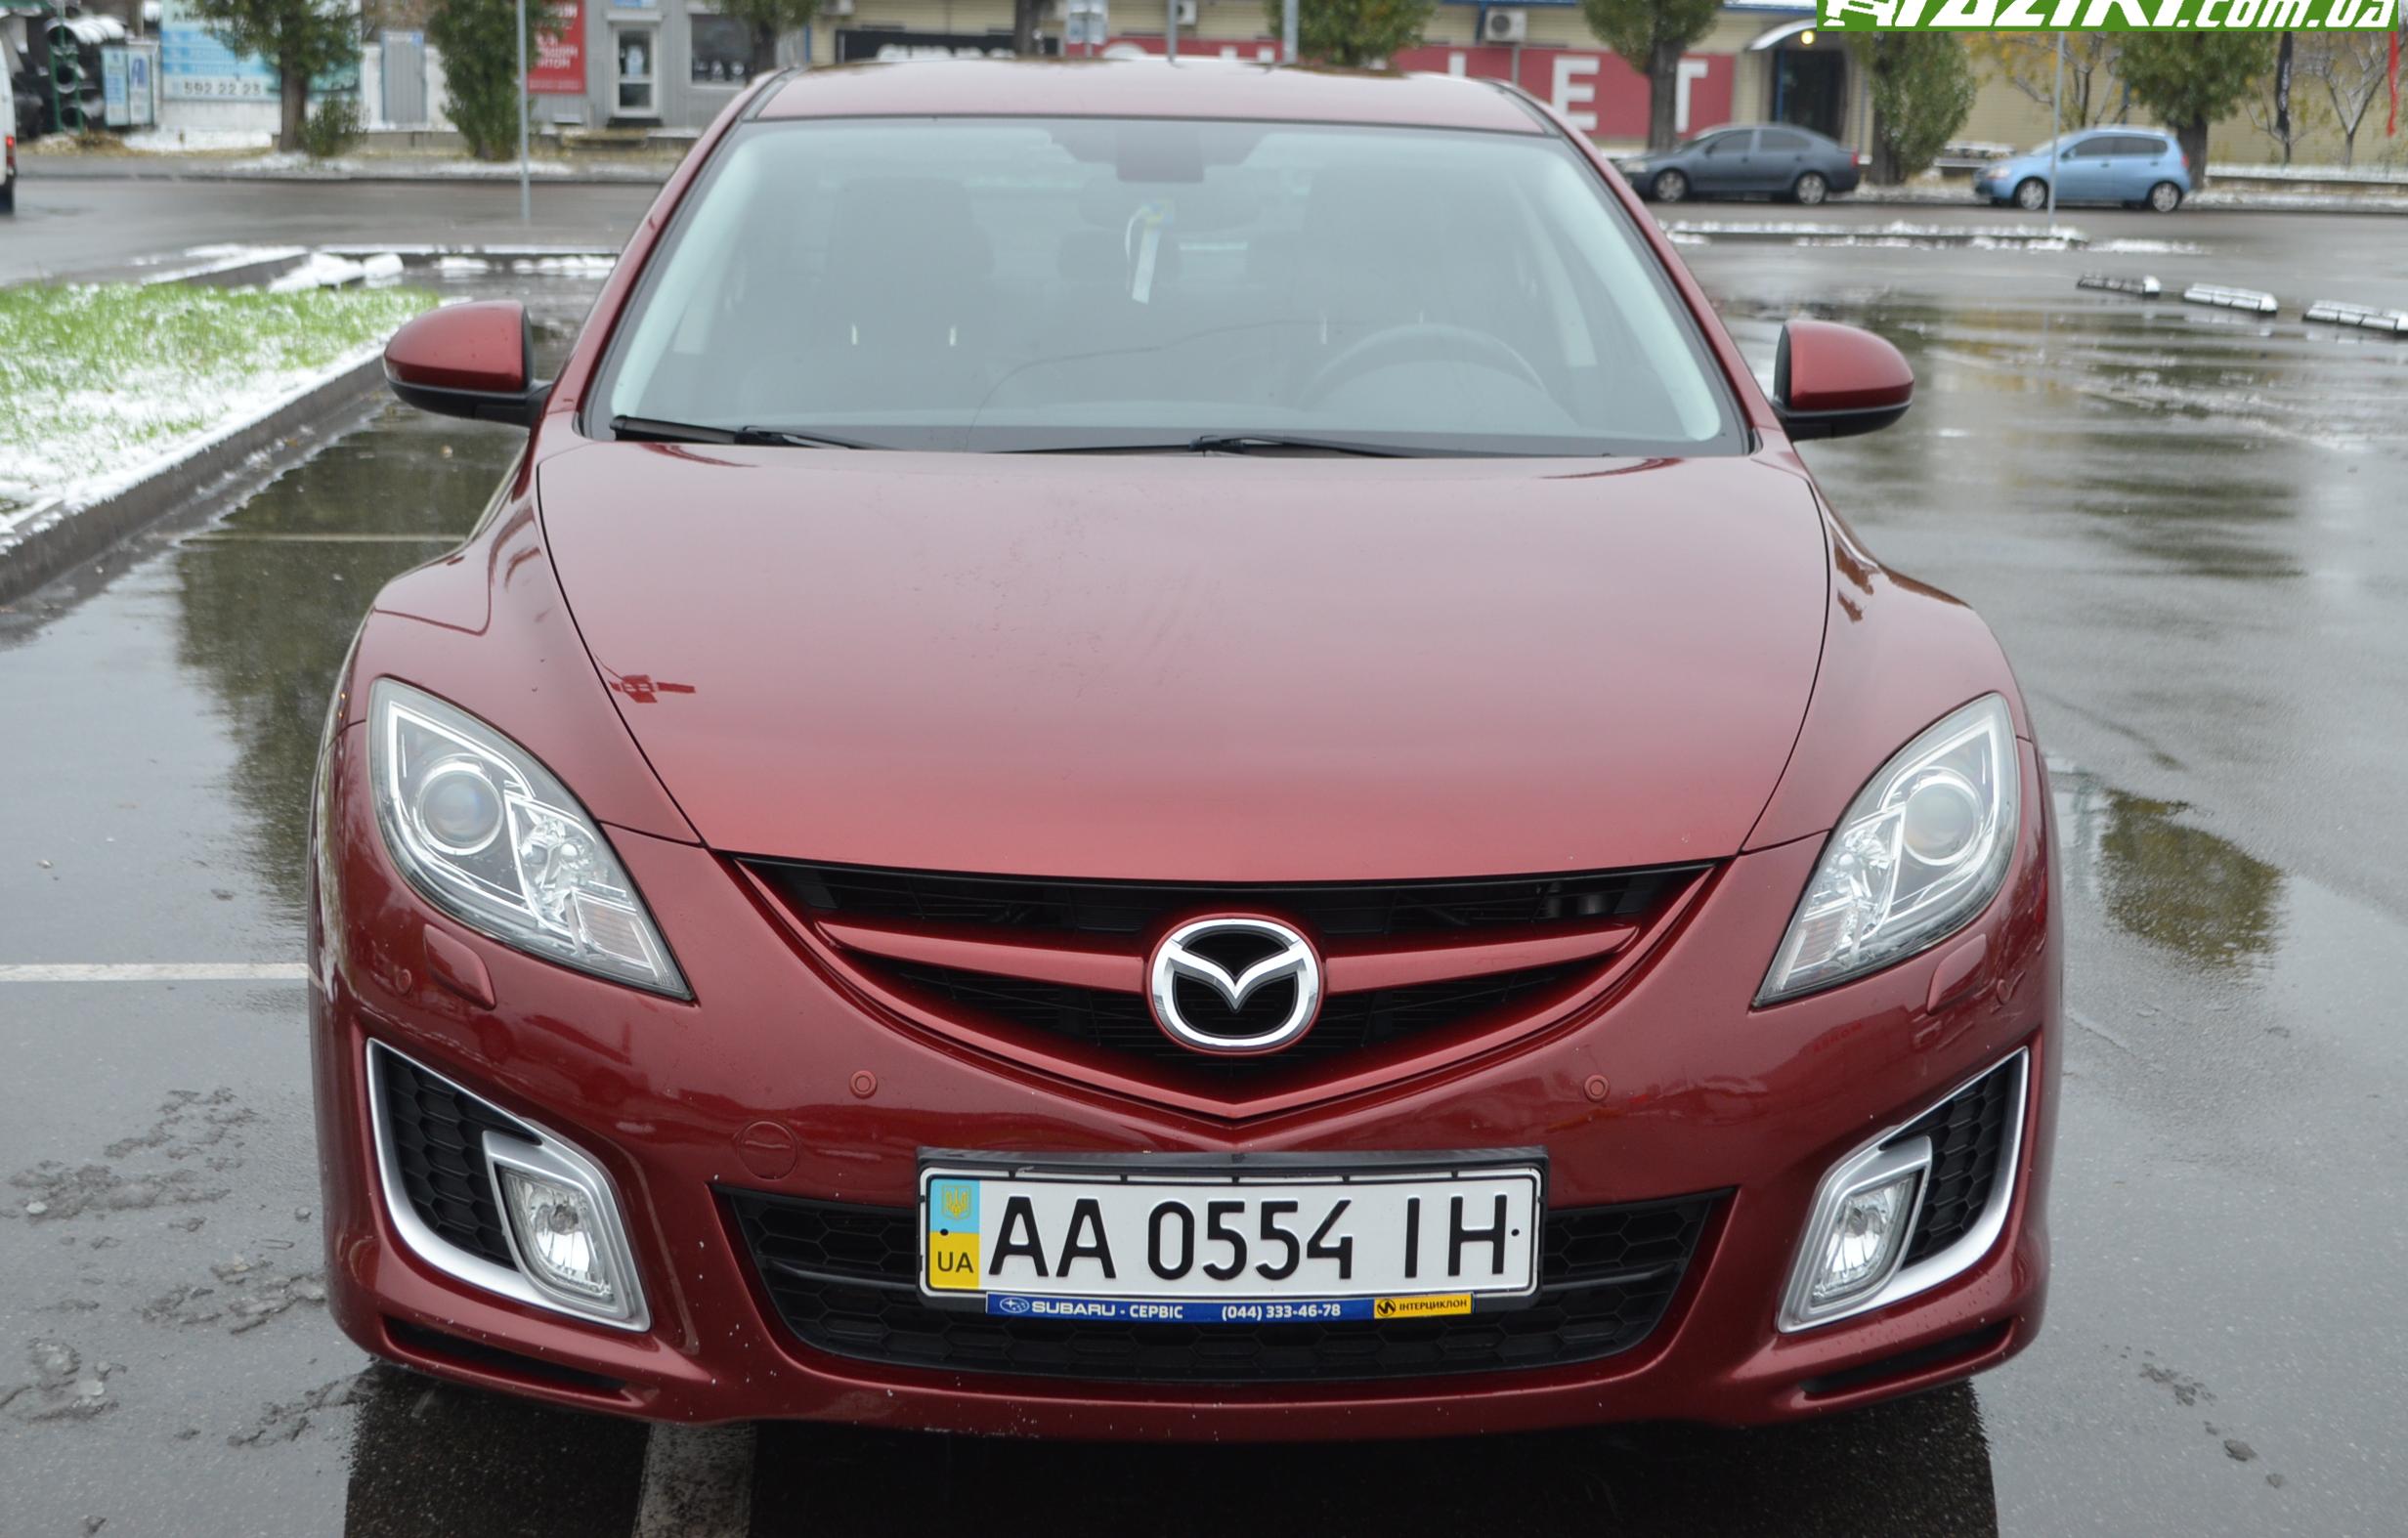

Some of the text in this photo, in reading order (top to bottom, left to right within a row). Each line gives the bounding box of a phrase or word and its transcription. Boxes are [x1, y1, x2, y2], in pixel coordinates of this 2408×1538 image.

[219, 82, 236, 95] 22
[988, 1194, 1509, 1281] AA 0554 IH
[937, 1252, 974, 1274] UA
[1031, 1301, 1116, 1316] SUBARU
[1129, 1304, 1183, 1319] СЕРВІС
[1222, 1304, 1263, 1321] (044)
[1266, 1303, 1342, 1319] 333-46-78
[1398, 1298, 1468, 1311] ІНТЕРЦИКЛОН
